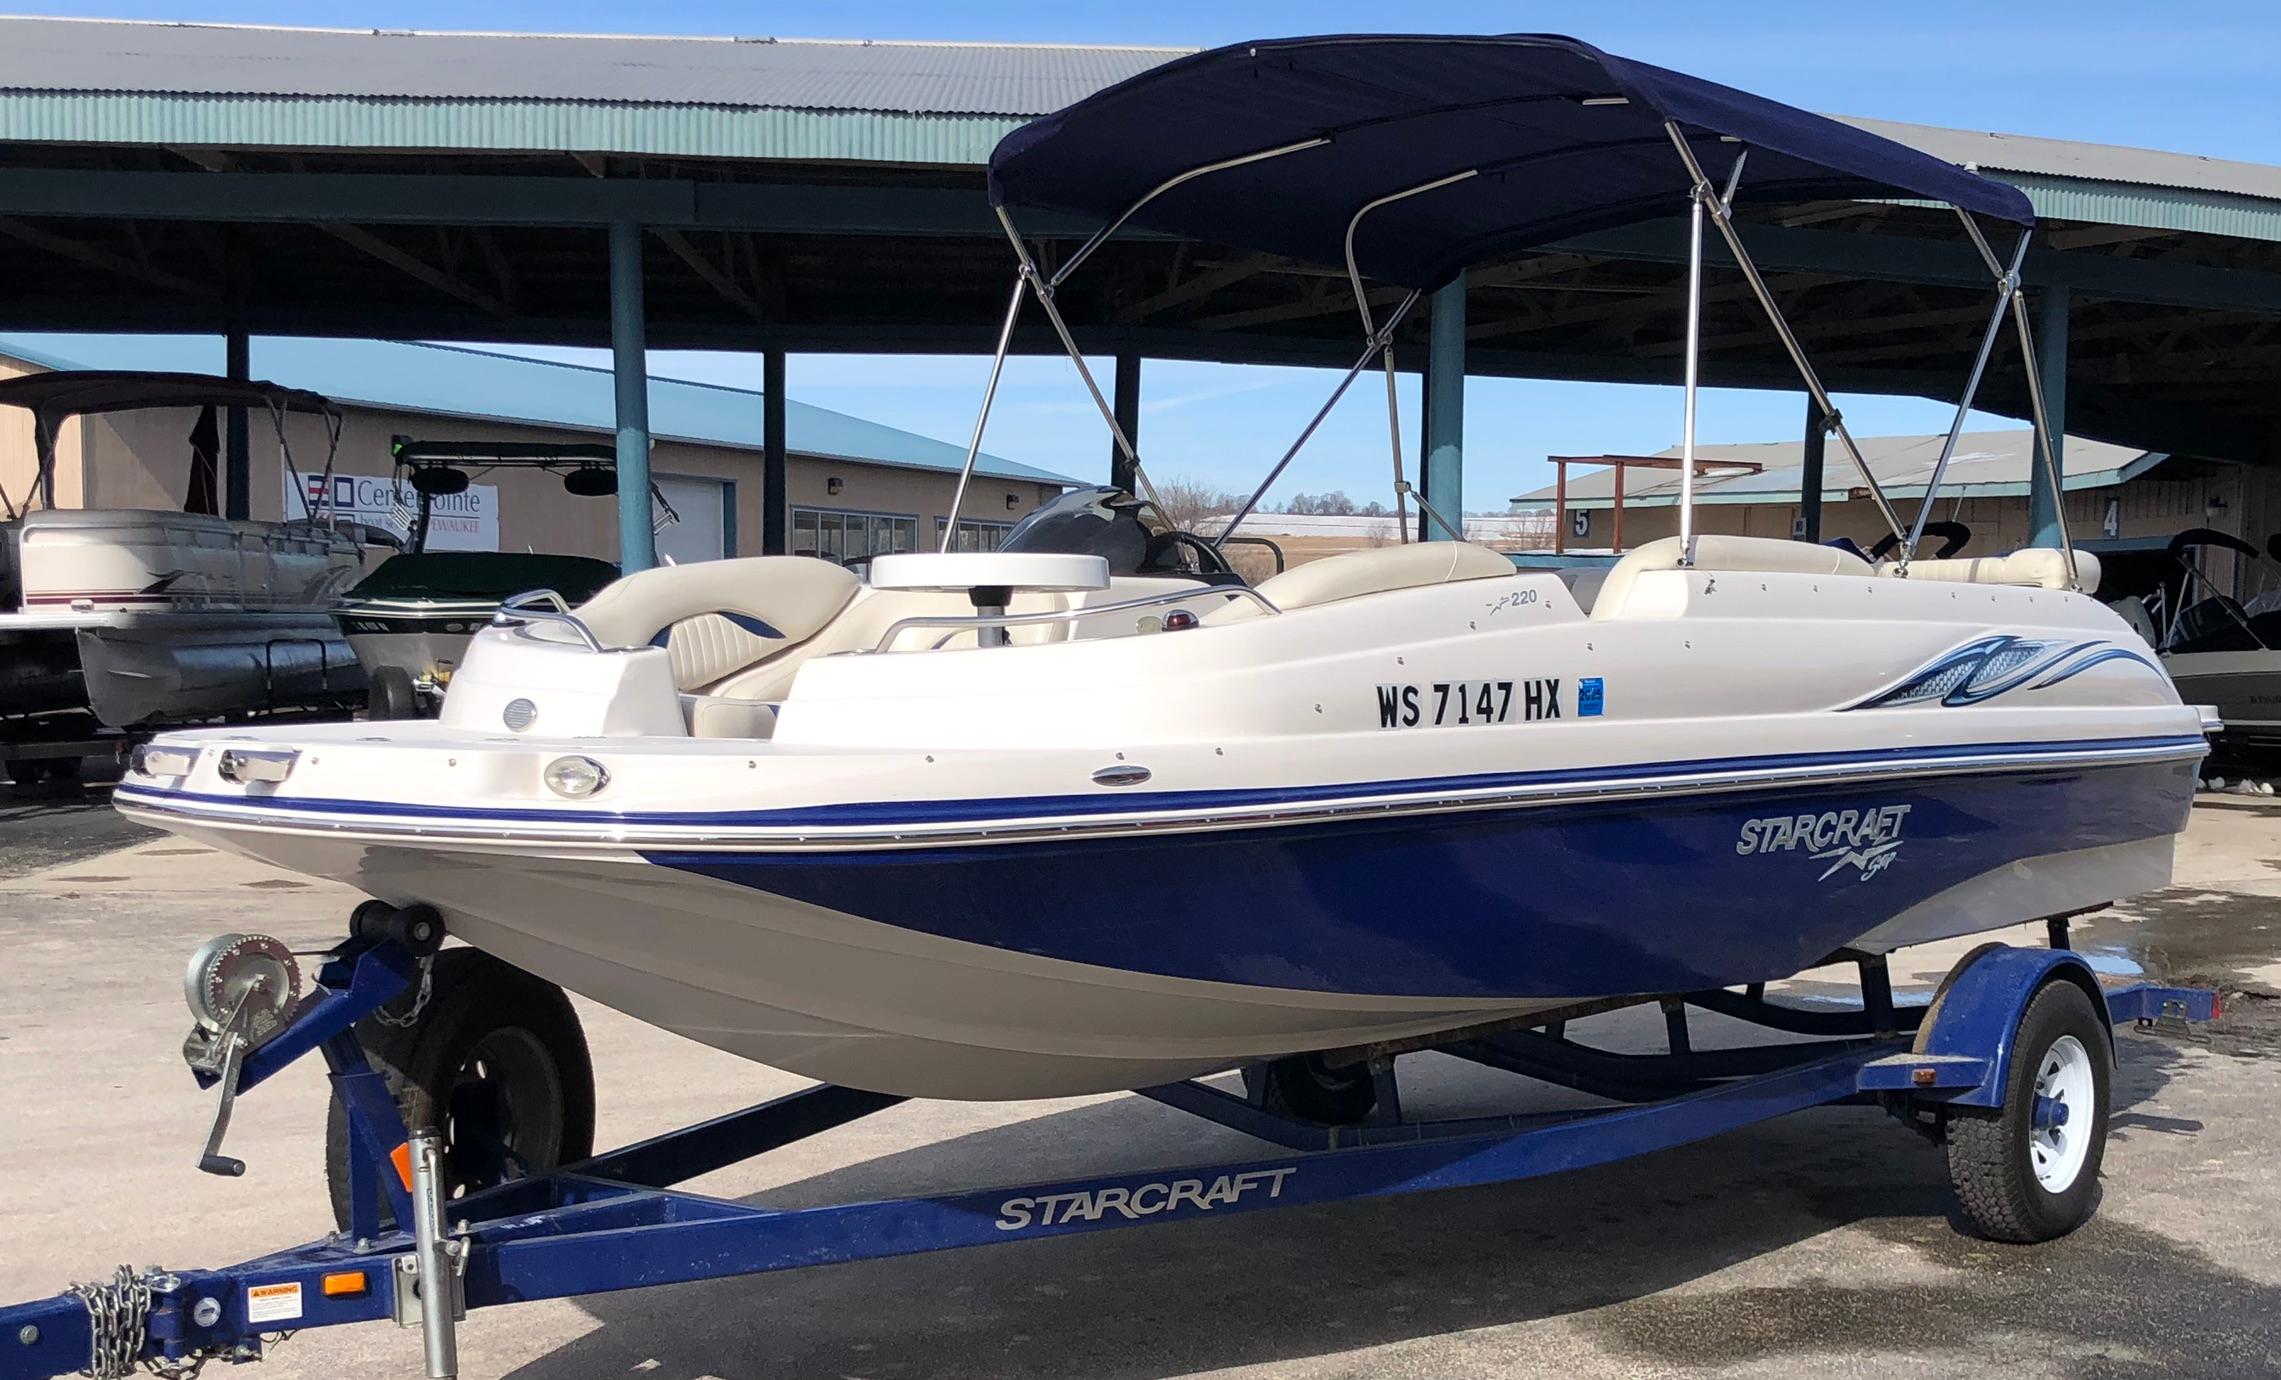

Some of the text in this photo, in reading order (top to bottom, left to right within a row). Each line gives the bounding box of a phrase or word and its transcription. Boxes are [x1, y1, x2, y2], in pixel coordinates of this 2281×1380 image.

[358, 480, 480, 513] Cenerointe
[1575, 510, 1588, 536] 5
[2103, 500, 2118, 537] 4
[1511, 589, 1537, 607] 220
[1376, 678, 1561, 729] WS 7147 HX
[1736, 804, 1912, 856] STARCRAFT
[995, 1167, 1297, 1231] STARCRAFT
[260, 1285, 298, 1297] WARNING
